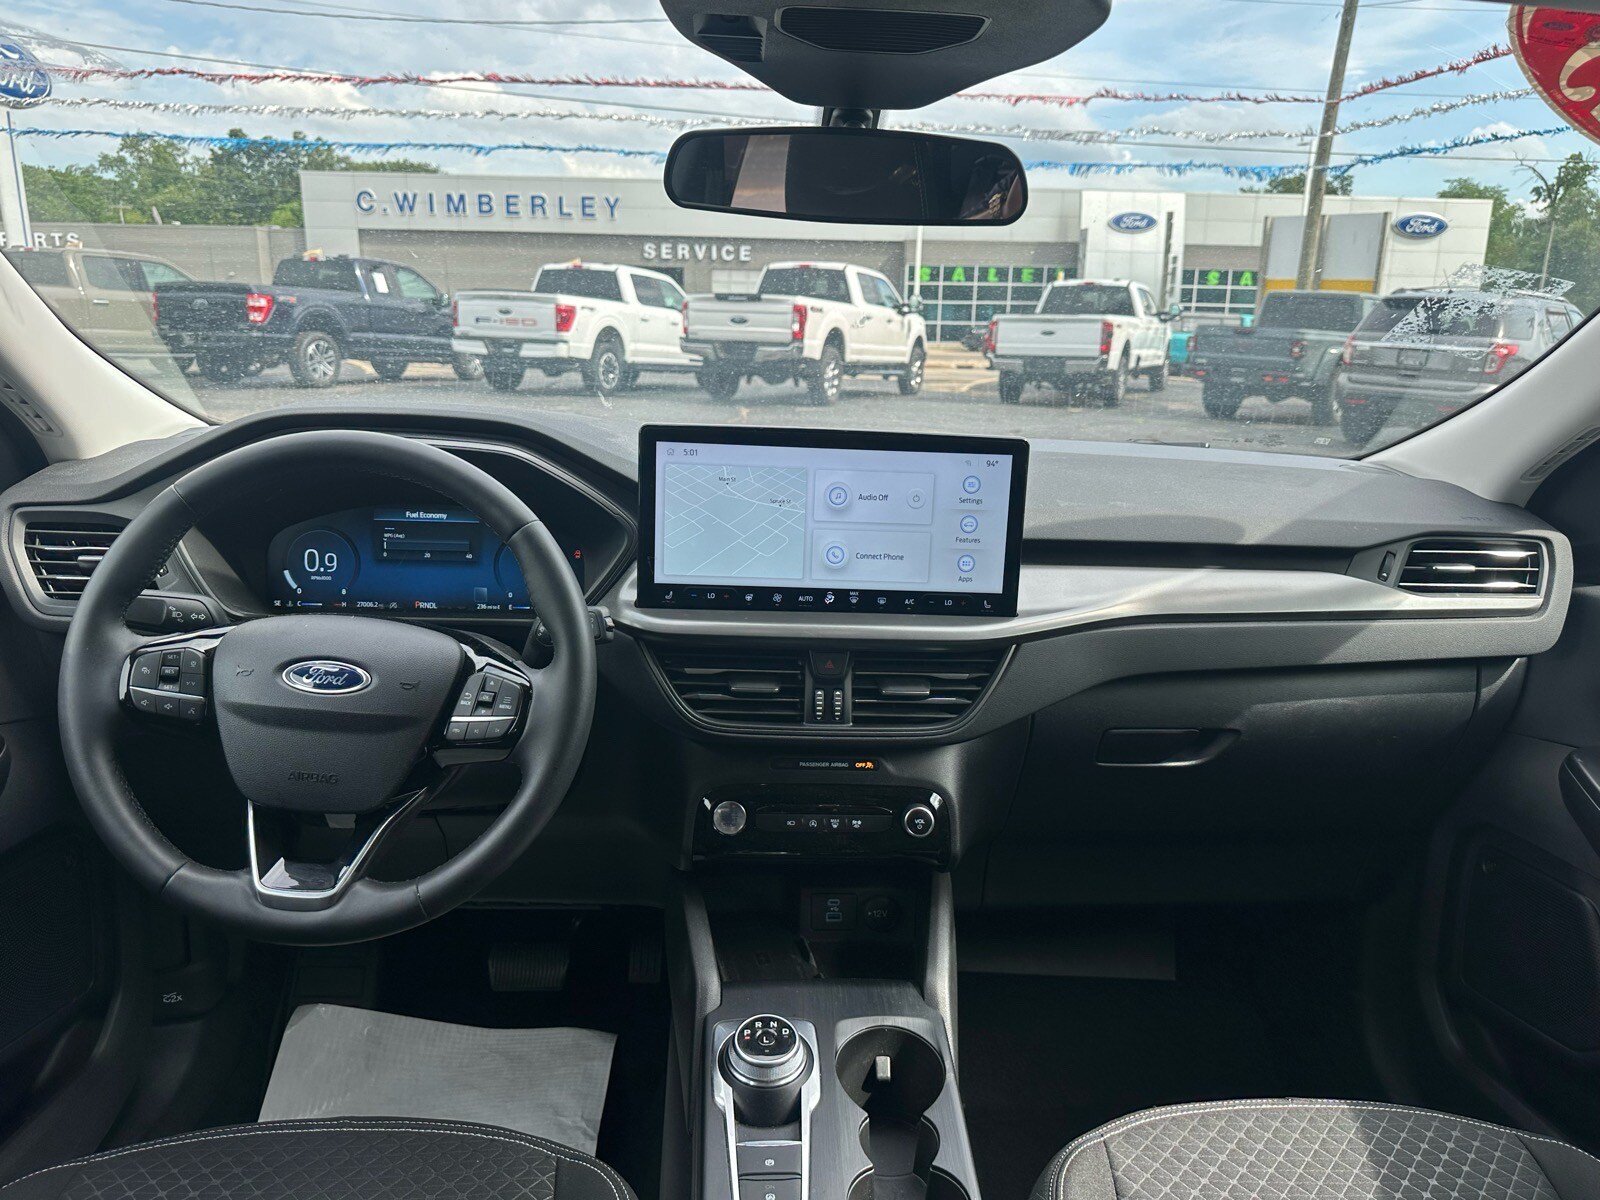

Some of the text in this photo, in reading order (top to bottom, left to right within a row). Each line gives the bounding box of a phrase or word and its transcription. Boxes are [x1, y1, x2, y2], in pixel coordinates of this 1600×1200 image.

[643, 242, 752, 262] SERVICE
[683, 448, 698, 457] 5:01
[858, 493, 889, 502] Audio Off
[958, 497, 983, 506] Settings
[405, 511, 447, 520] Fuel Economy
[955, 536, 981, 545] Features
[304, 548, 338, 573] 0.9
[855, 552, 905, 561] Connect Phone
[957, 575, 973, 583] Apps
[707, 592, 716, 600] LO
[302, 664, 349, 687] Ford
[287, 770, 339, 785] AIRBAG
[914, 817, 926, 825] VOL
[770, 1020, 778, 1028] N
[782, 1027, 790, 1035] D
